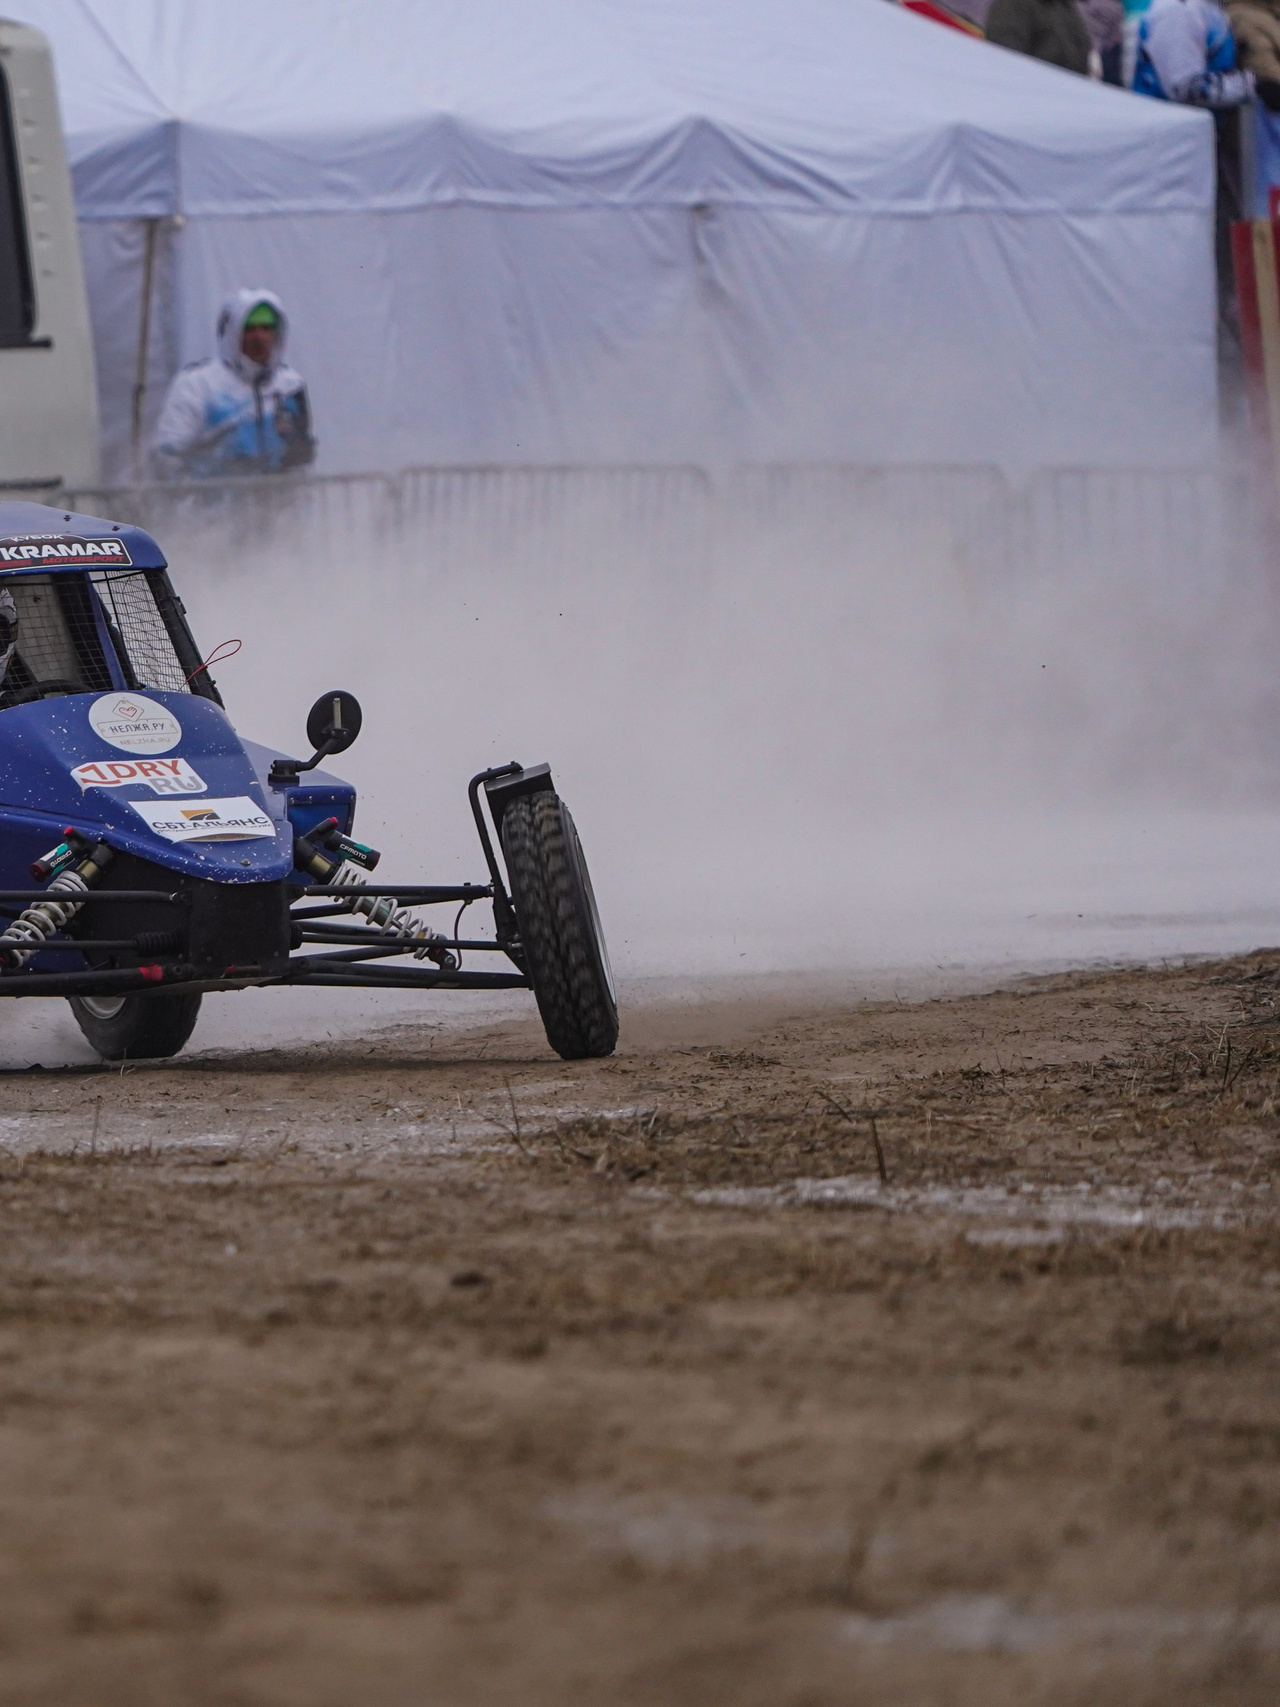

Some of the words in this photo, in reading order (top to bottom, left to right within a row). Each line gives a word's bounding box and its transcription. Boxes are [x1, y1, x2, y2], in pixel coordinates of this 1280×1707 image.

[0, 542, 124, 561] KRAMAR
[42, 555, 125, 564] MOTORSPORT
[109, 722, 165, 735] НЕЛЖА.РУ
[119, 736, 172, 746] NELZHA.RU
[78, 759, 182, 784] 1DRY
[148, 775, 203, 793] RU
[151, 815, 269, 830] СБТ-АЛЬЯНС
[339, 843, 367, 860] CFMOTO
